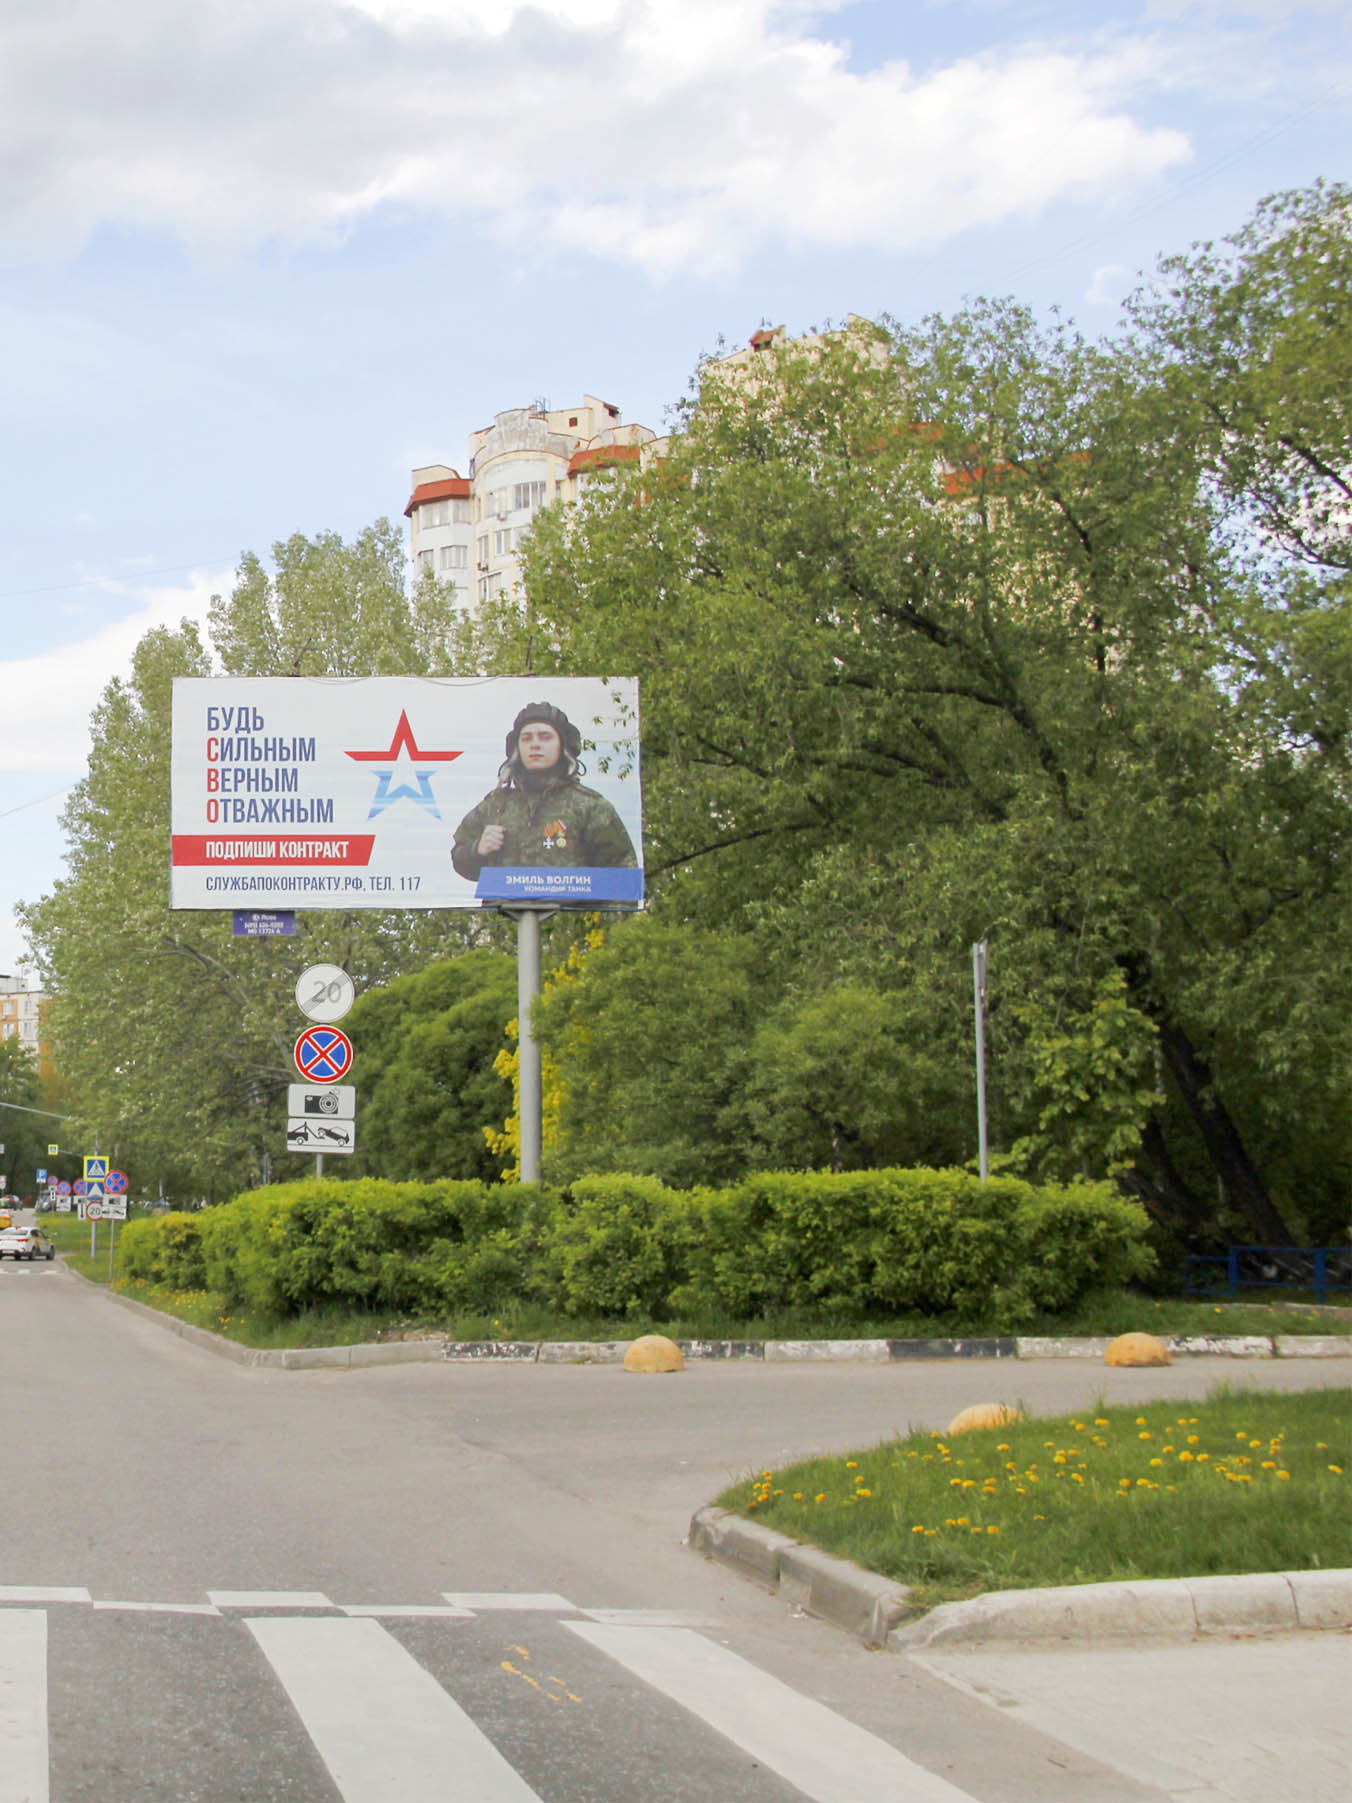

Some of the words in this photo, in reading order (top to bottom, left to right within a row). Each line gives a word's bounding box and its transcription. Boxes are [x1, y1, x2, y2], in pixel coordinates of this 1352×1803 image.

[207, 707, 264, 733] БУДЬ
[207, 737, 316, 762] СИЛЬНЫМ
[207, 768, 298, 792] ВЕРНЫМ
[207, 798, 334, 823] ОТВАЖНЫМ
[205, 841, 276, 860] ПОДПИШИ
[279, 841, 349, 858] КОНТРАКТ
[206, 876, 366, 892] СЛУЖБАПОКОНТРАКТУ.РФ,
[369, 876, 395, 891] ТЕЛ.
[400, 876, 421, 891] 117
[505, 875, 544, 884] ЭМИЛЬ
[547, 875, 592, 884] ВОЛГИН
[311, 980, 342, 1004] 20
[90, 1207, 101, 1215] 20
